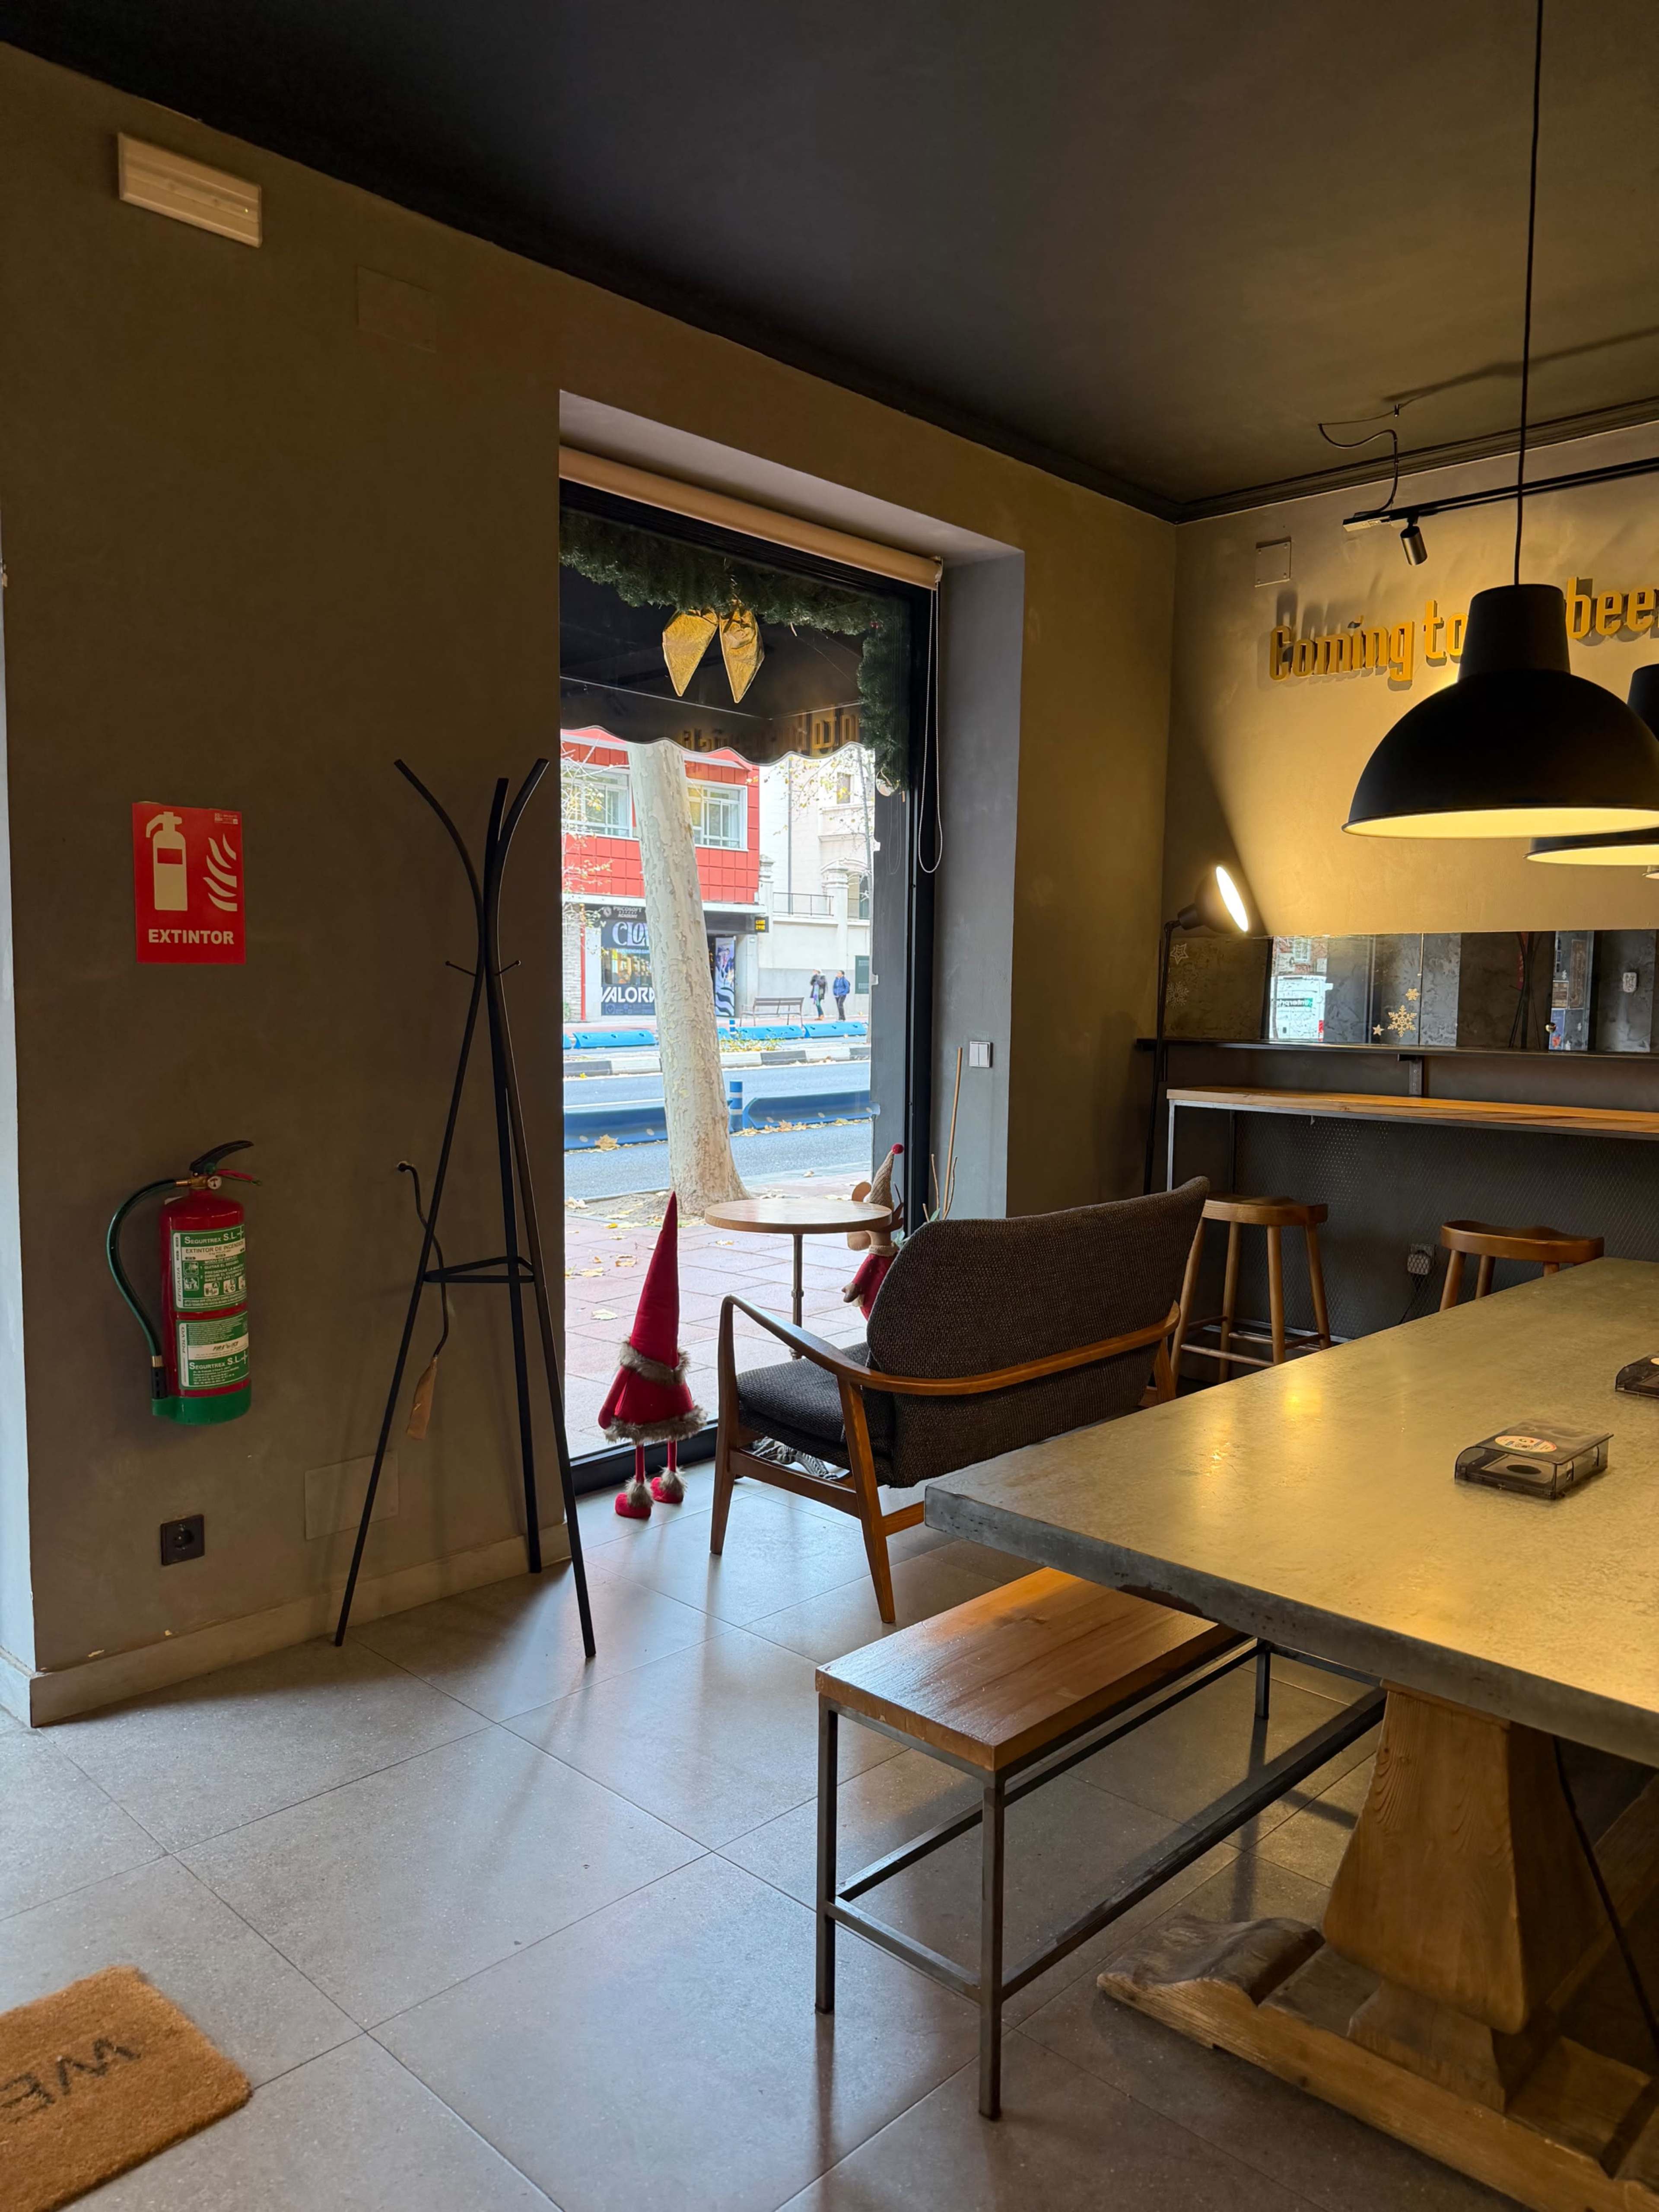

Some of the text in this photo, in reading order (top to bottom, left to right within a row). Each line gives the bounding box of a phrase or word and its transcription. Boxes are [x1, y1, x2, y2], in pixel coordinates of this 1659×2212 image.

[1269, 615, 1414, 681] Coming
[1565, 576, 1659, 639] bee
[148, 929, 234, 945] EXTINTOR
